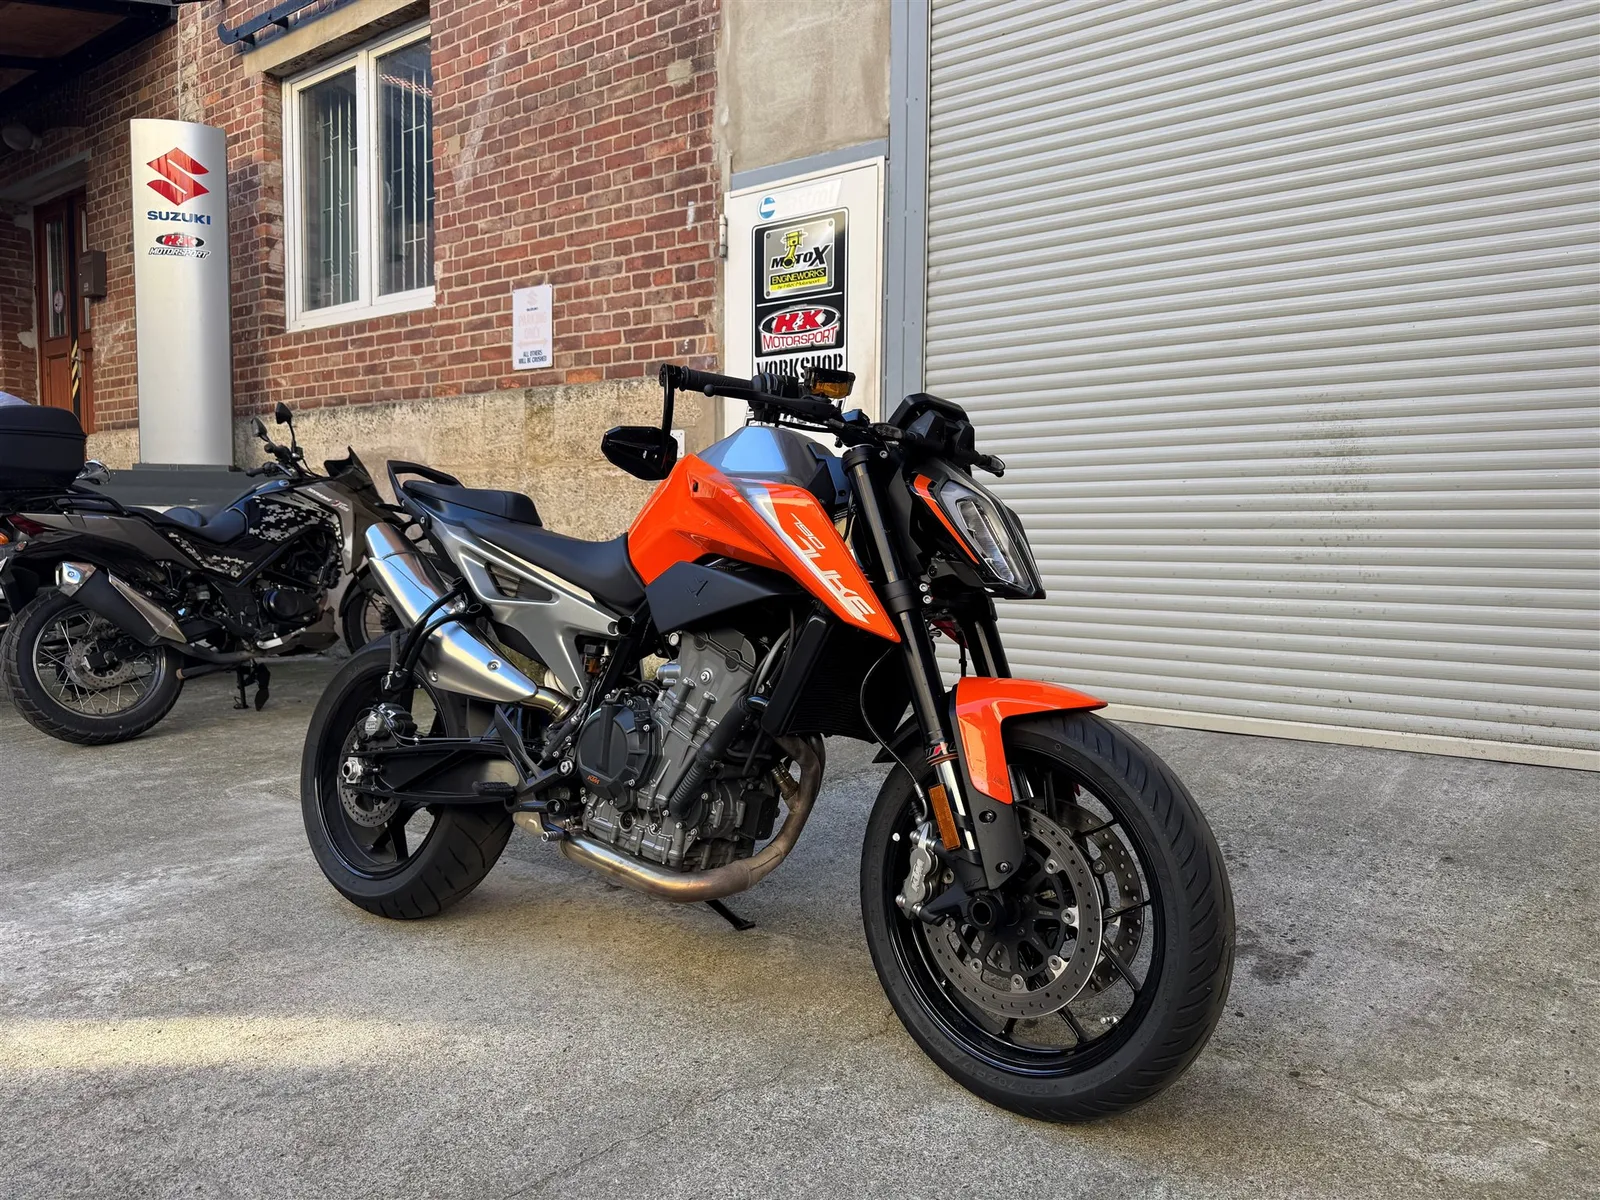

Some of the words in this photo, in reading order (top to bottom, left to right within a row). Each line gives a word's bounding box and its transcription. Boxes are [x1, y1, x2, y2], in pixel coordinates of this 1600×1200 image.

[147, 210, 211, 225] SUZUKI
[148, 247, 211, 259] MOTORSPORT
[771, 268, 825, 285] ENGINEWORKS
[762, 325, 838, 351] MOTORSPORT
[790, 512, 826, 549] 790
[796, 533, 877, 624] DUKE
[586, 775, 600, 785] KTM
[910, 859, 924, 893] KTM
